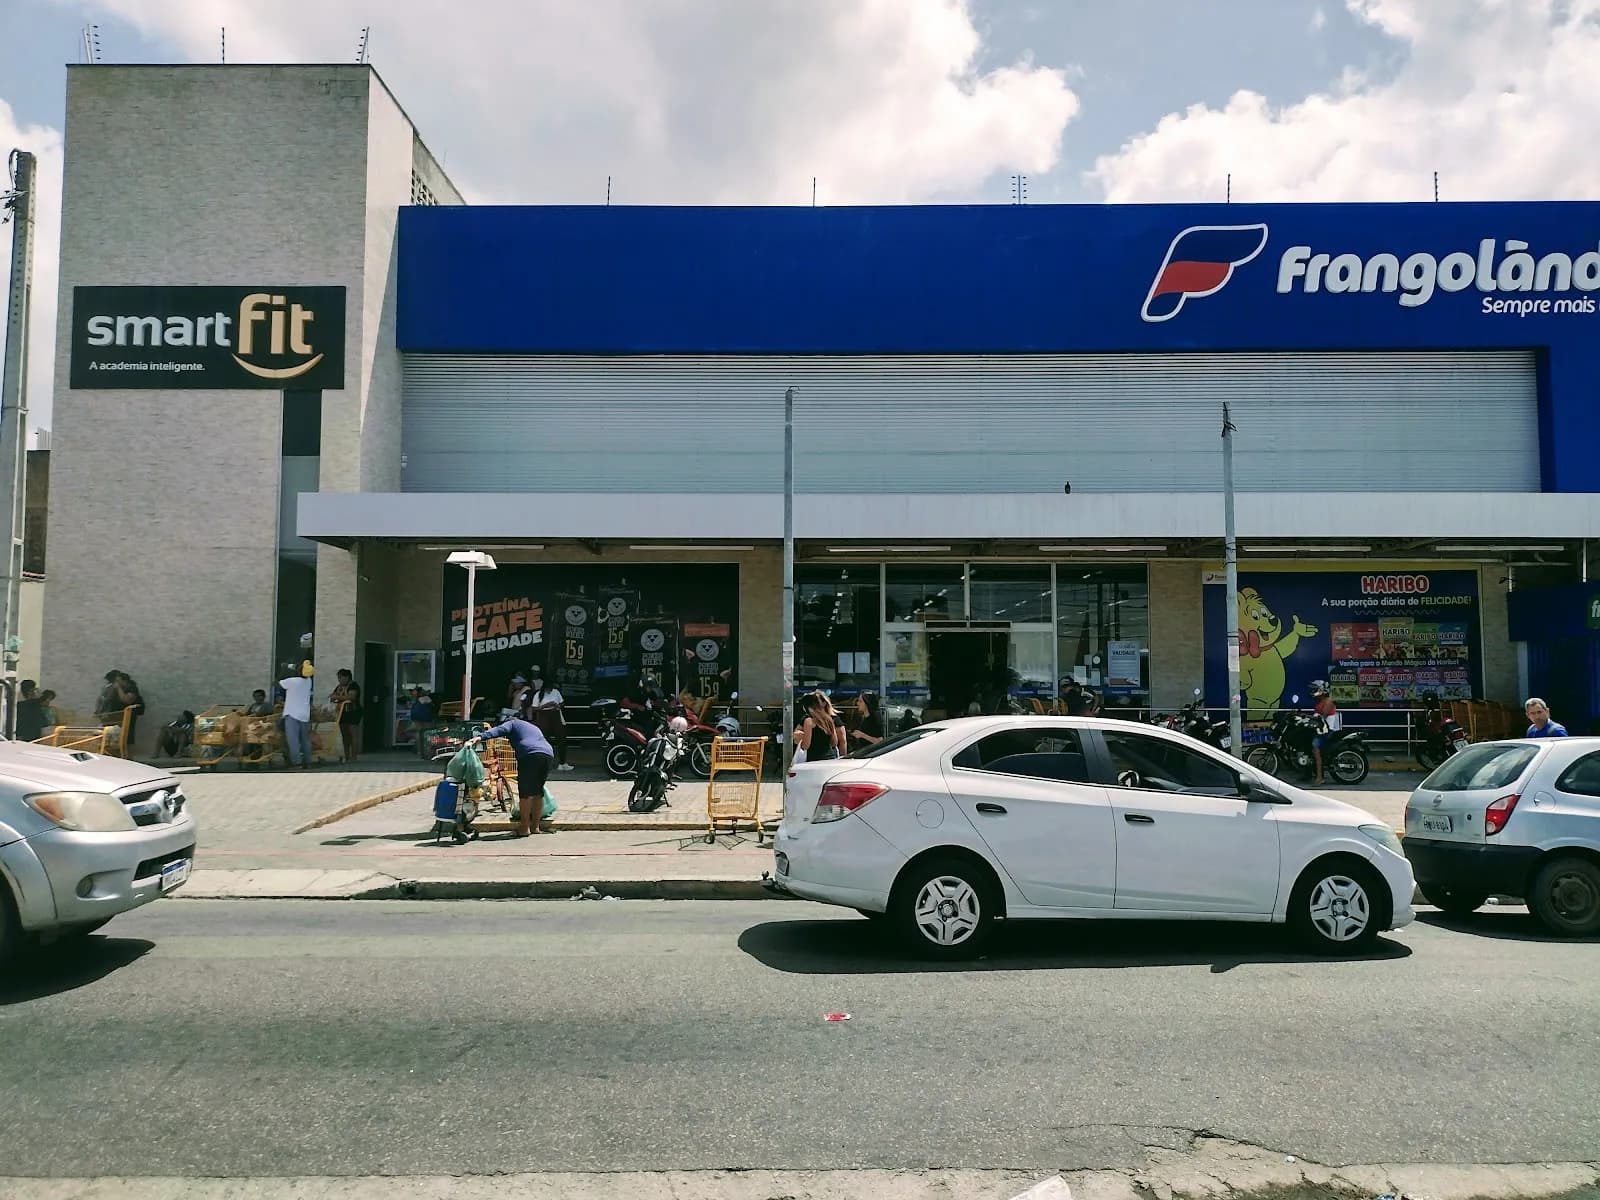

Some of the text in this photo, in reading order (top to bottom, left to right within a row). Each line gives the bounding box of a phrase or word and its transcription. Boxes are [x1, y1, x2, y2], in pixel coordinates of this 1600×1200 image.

[1481, 297, 1550, 317] Sempre
[1554, 296, 1596, 314] mais
[87, 292, 314, 355] smart fit
[89, 361, 206, 373] A academia inteligente.
[1362, 575, 1429, 594] HARIBO
[1321, 598, 1329, 606] A
[1330, 599, 1347, 607] sua
[1348, 597, 1379, 608] porção
[1380, 596, 1405, 606] diária
[1420, 595, 1472, 606] FELICIDADE!
[451, 624, 465, 642] E
[473, 601, 544, 641] CAFÉ
[462, 630, 543, 658] VERDADE
